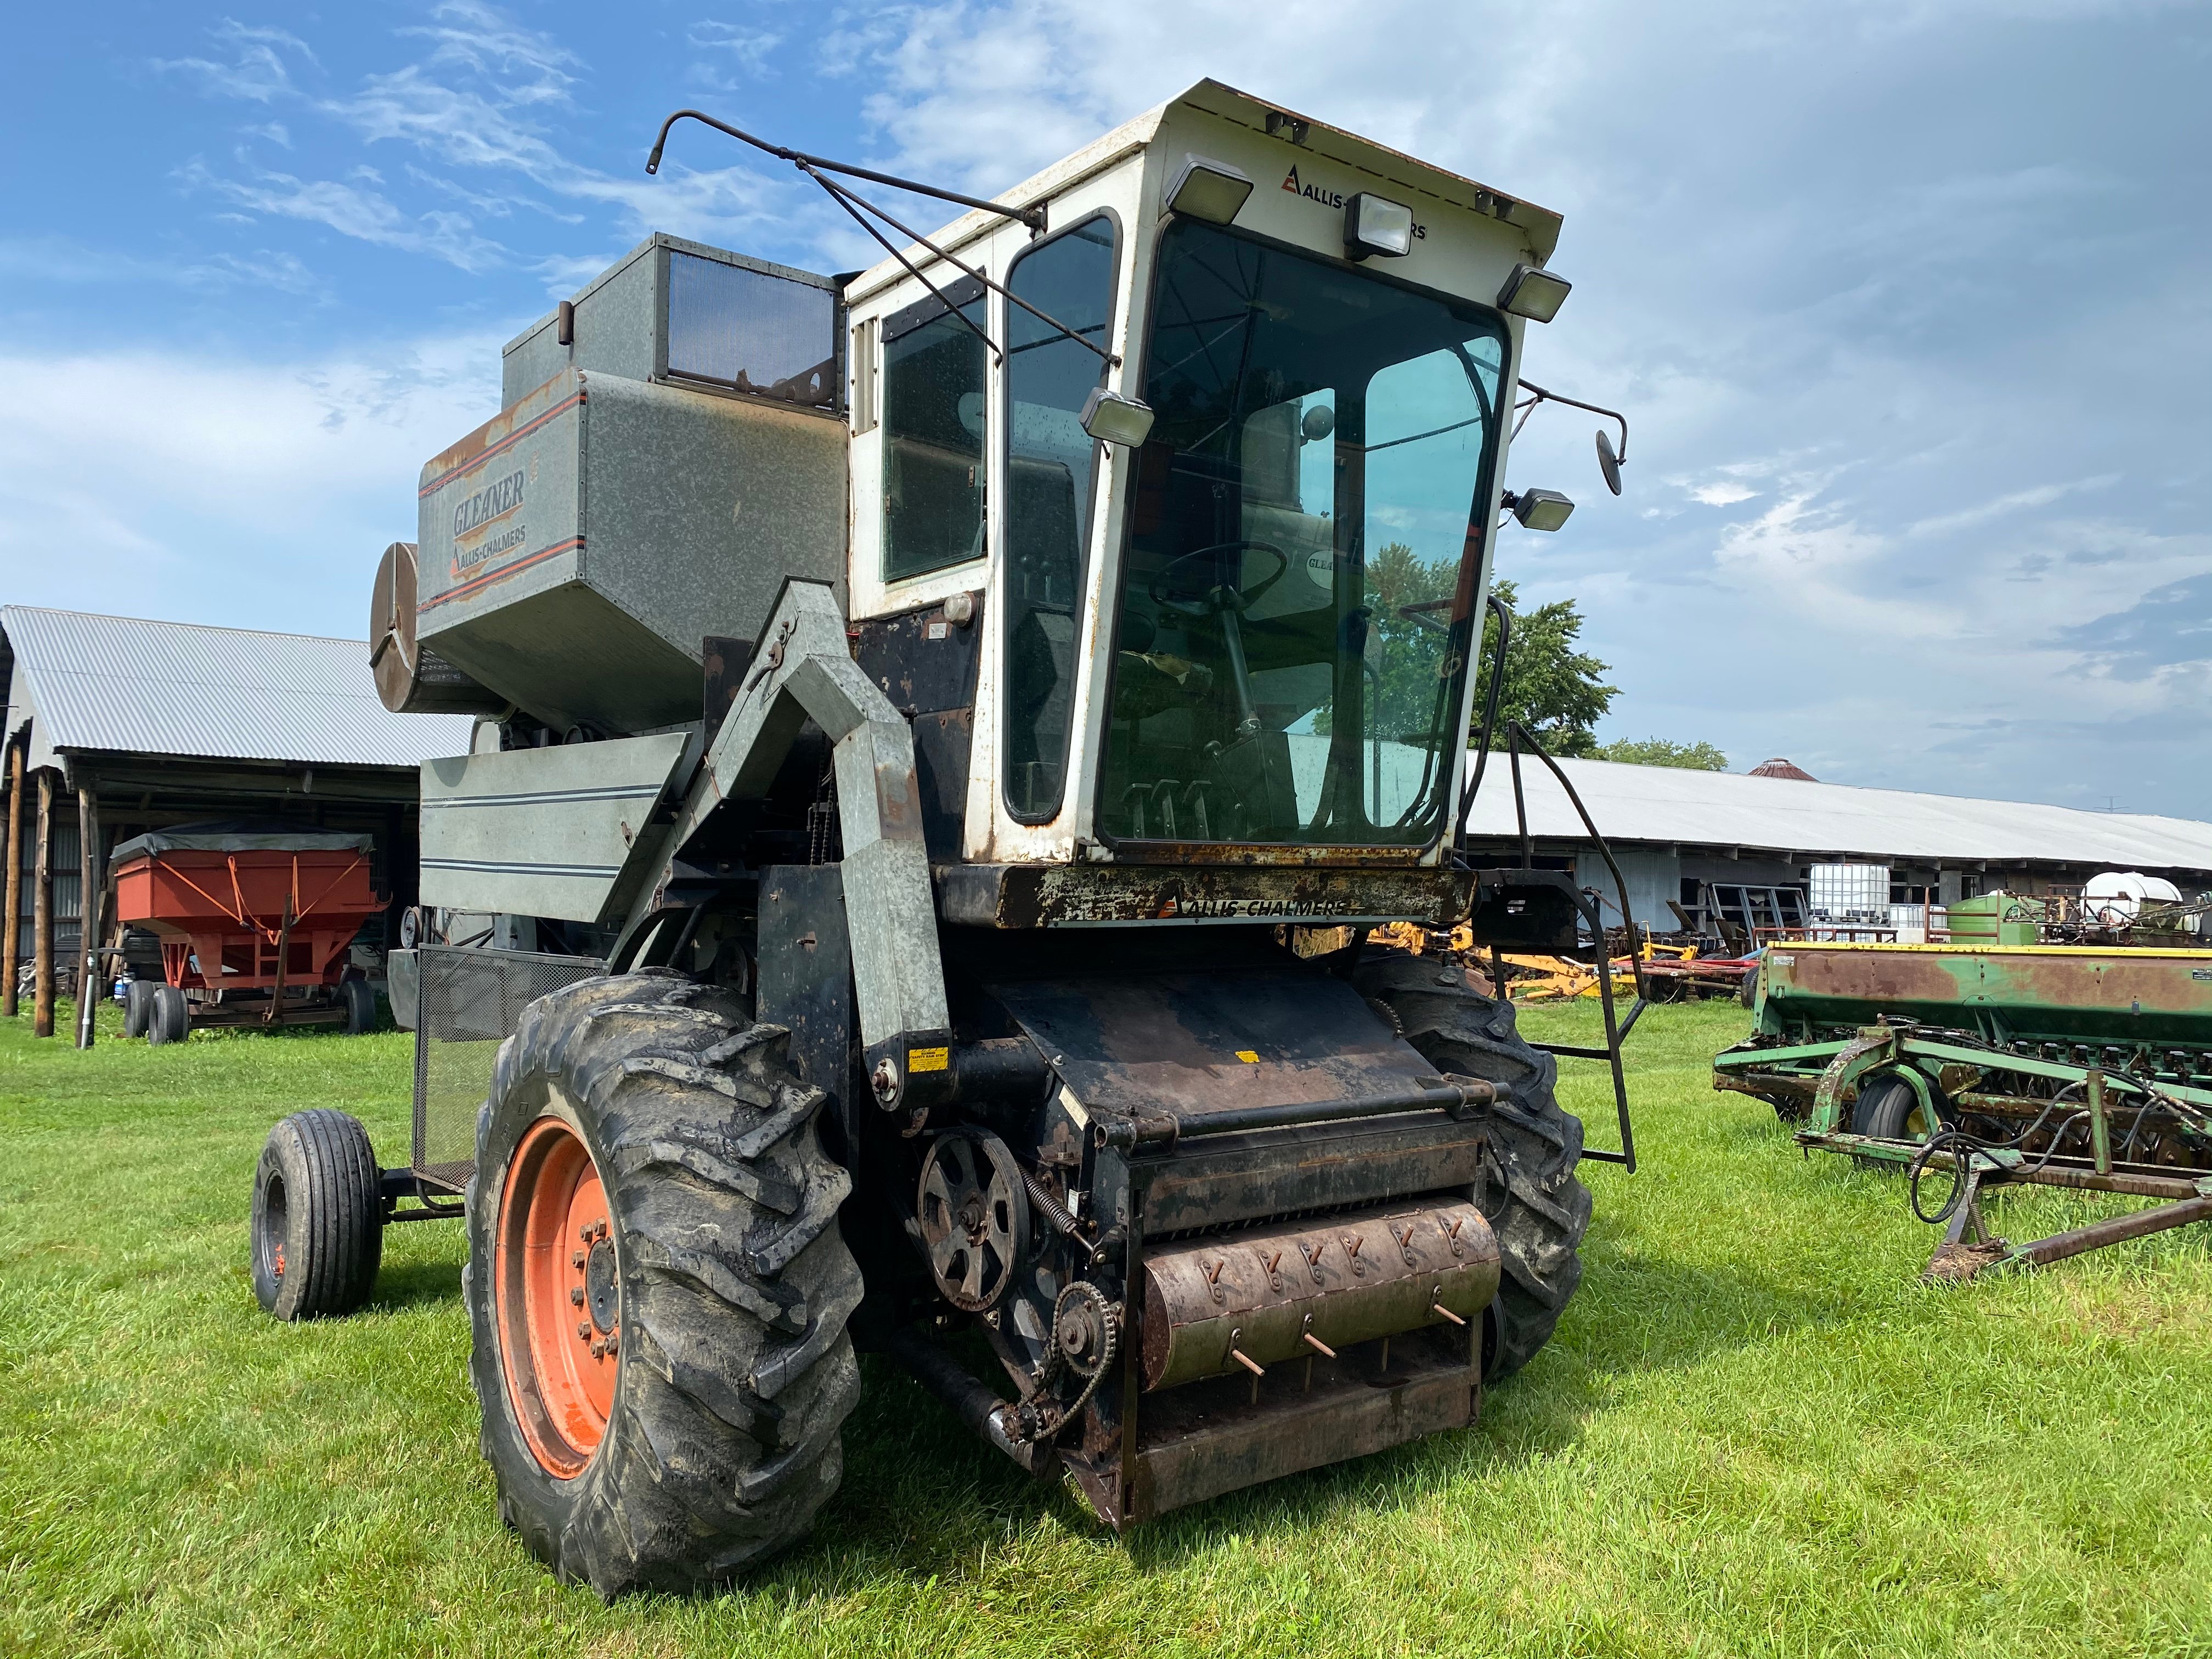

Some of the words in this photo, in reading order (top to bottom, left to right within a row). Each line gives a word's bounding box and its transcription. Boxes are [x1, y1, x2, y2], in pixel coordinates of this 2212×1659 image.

[1302, 184, 1426, 240] ALLIS-RS
[454, 470, 524, 537] GLEANER
[461, 524, 526, 569] ALLIS-CHALMERS
[1309, 558, 1333, 571] GLEA
[1187, 900, 1346, 917] ALLIS-CHALMERS
